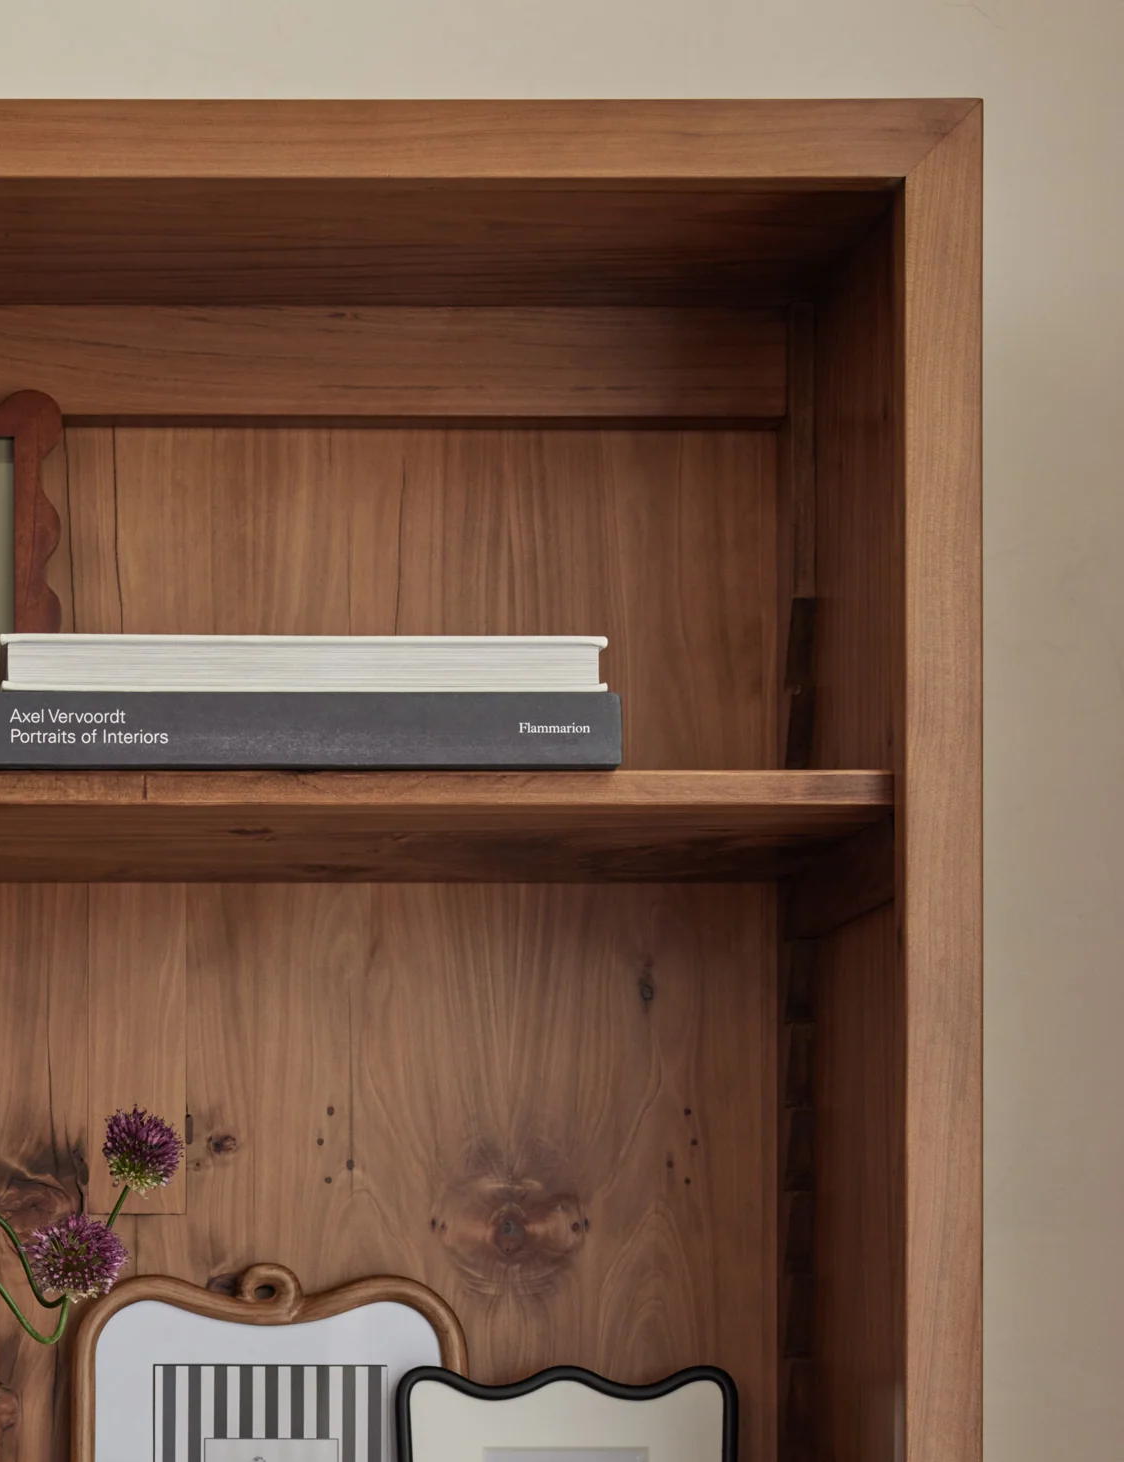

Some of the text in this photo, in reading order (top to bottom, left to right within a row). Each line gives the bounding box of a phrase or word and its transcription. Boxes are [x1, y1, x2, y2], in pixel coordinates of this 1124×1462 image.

[9, 708, 126, 724] Axel Vervoordt
[10, 728, 169, 744] Portraits of Interiors
[518, 722, 591, 734] Flammarion
